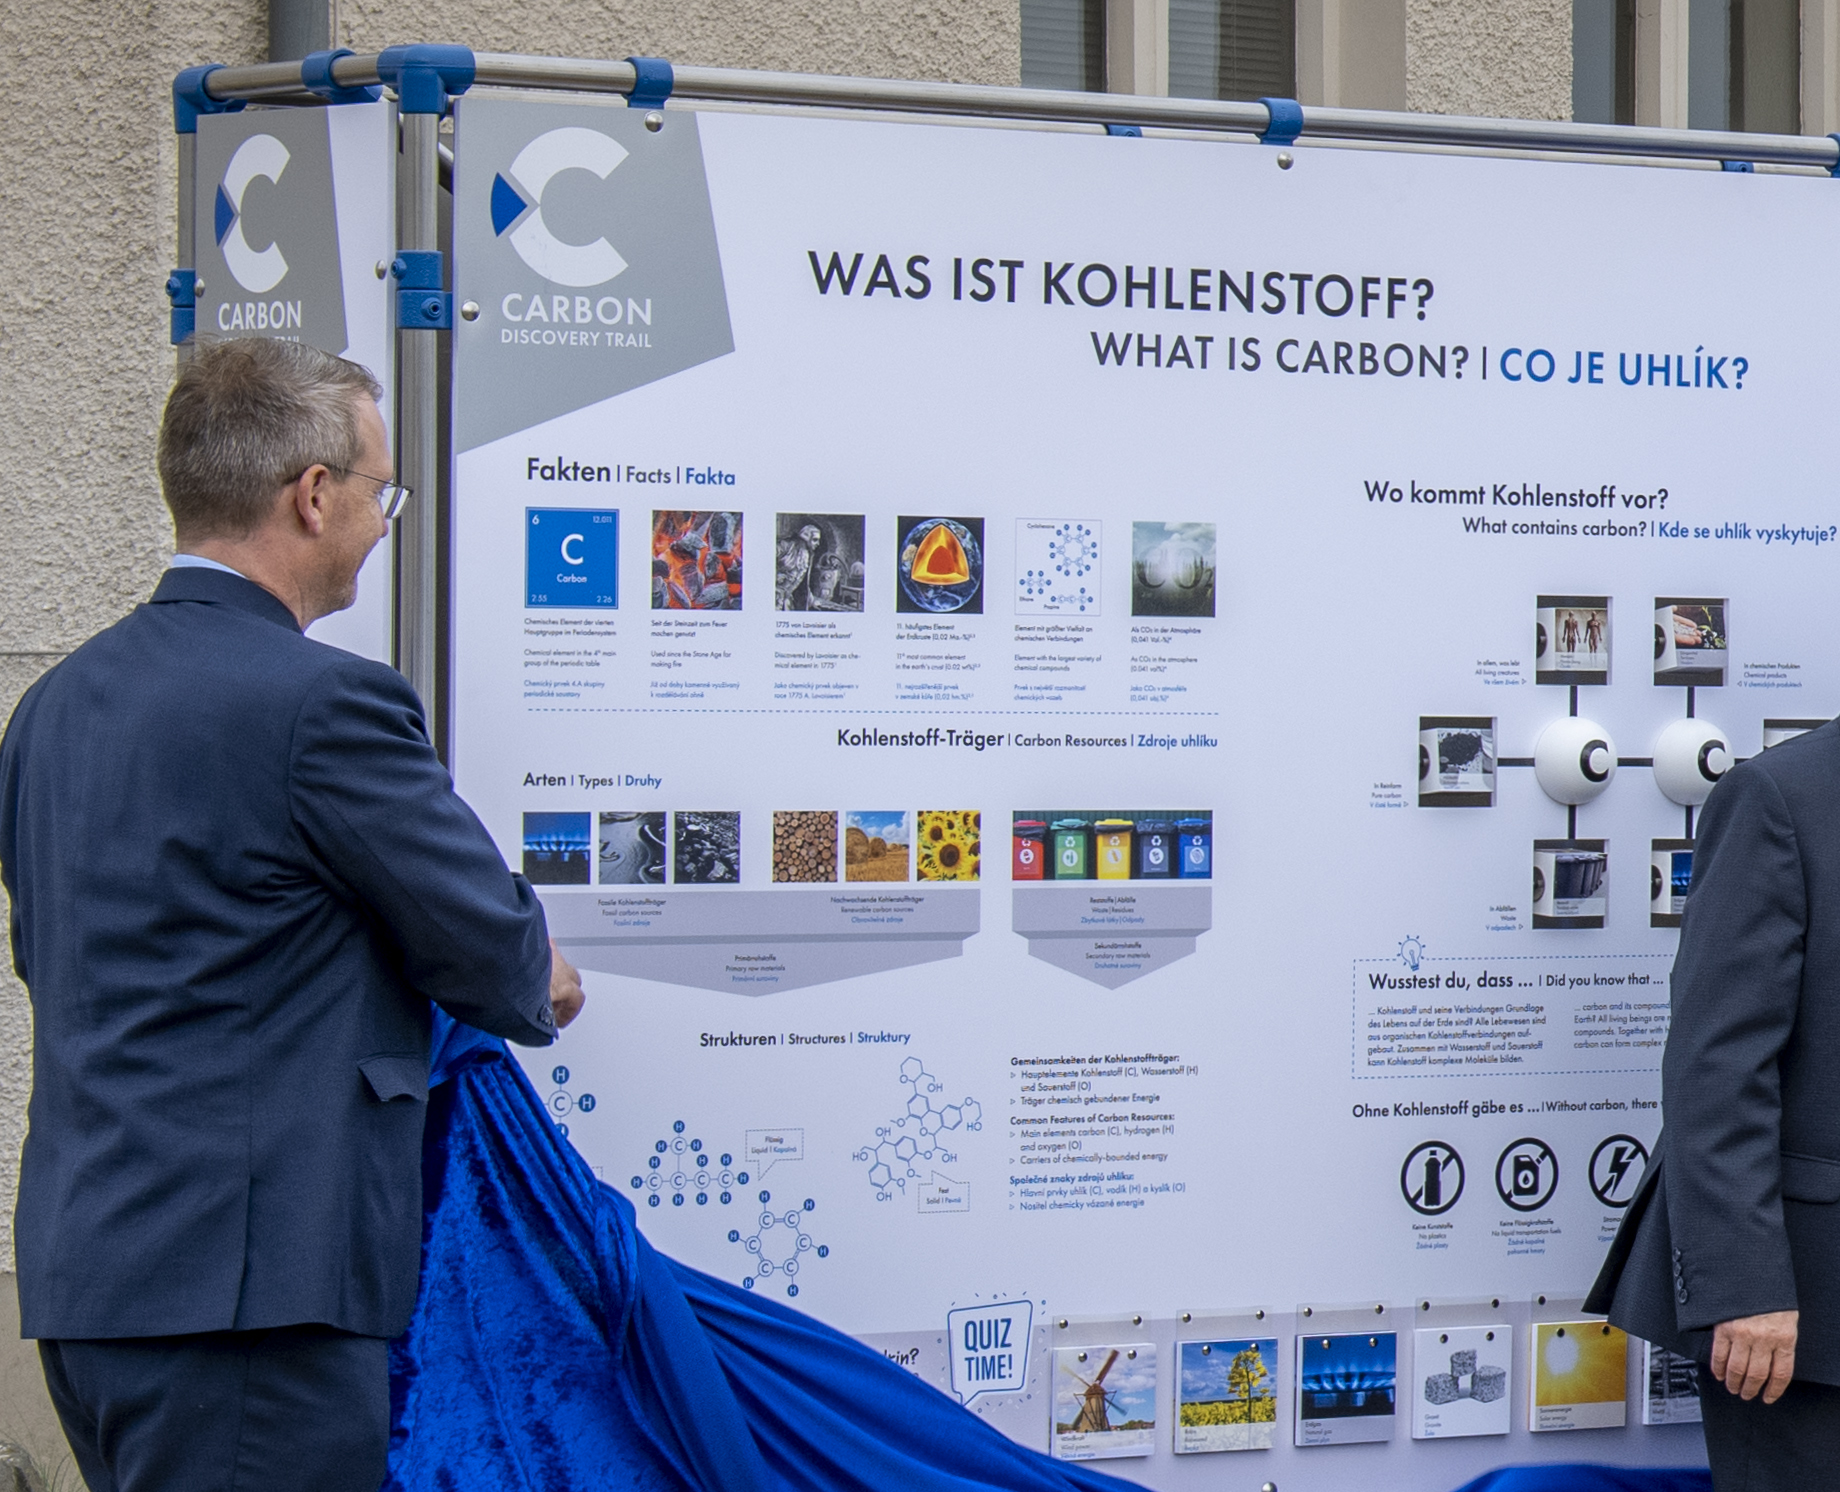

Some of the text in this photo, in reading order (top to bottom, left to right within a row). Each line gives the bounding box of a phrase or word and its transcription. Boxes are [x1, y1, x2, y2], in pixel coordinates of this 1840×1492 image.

[807, 250, 1436, 323] WAS IST KOHLENSTOFF?
[215, 300, 302, 331] CARBON
[500, 292, 652, 326] CARBON
[501, 328, 652, 348] DISCOVERY TRAIL
[1090, 331, 1749, 390] WHAT IS CARBON? CO JE UHLÍK?
[527, 456, 736, 486] Fakten Facts Fakta
[1363, 479, 1669, 510] Wo kommt Kohlenstoff vor?
[532, 514, 540, 525] 6
[1462, 515, 1838, 546] What contains carbon? Kde se uhlík vyskytuje?
[561, 533, 584, 565] C
[556, 573, 588, 584] Carbon
[837, 727, 1218, 752] Kohlenstoff-Träger Carbon Resources Zdroje uhlíku
[522, 771, 662, 790] Arten Types Druhy
[1368, 970, 1514, 991] Wusstest du, dass
[699, 1030, 911, 1048] Strukturen Structures Struktury
[1352, 1099, 1524, 1119] Ohne Kohlenstoff gäbe es
[964, 1317, 1012, 1352] QUIZ
[964, 1353, 1013, 1382] TIME!
